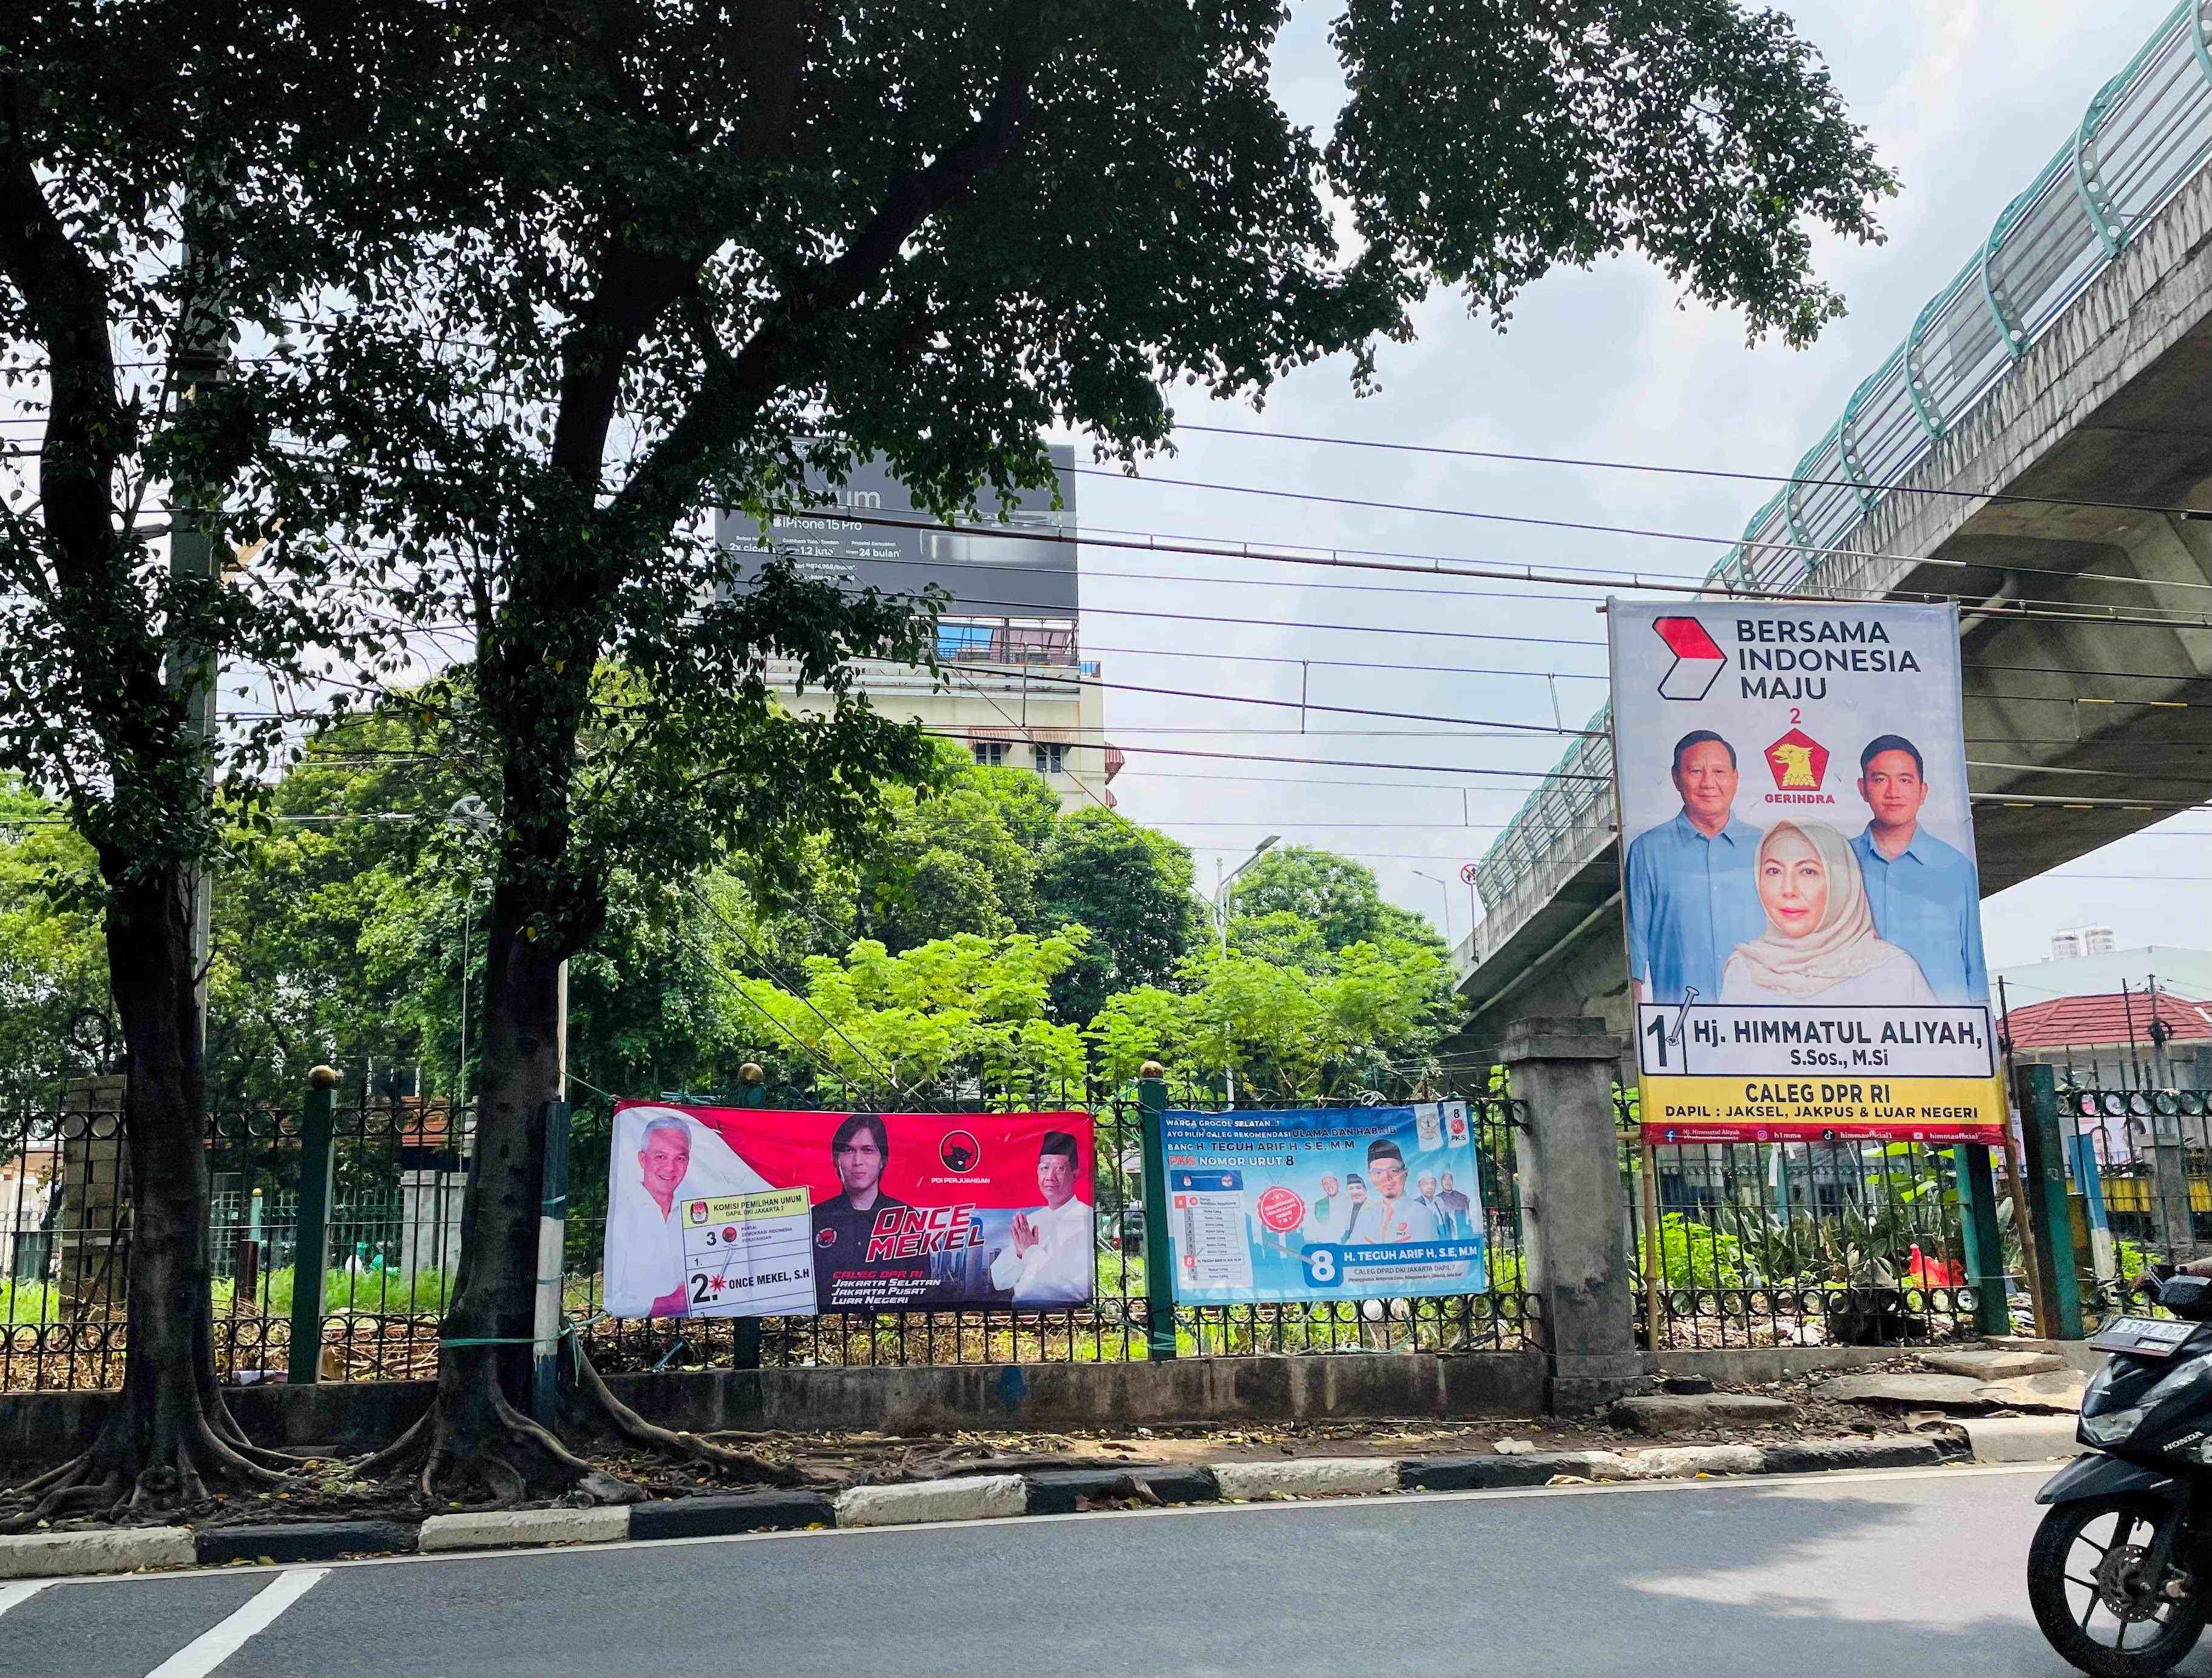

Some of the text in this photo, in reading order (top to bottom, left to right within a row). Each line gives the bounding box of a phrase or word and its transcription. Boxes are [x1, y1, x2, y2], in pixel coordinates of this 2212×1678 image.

[783, 516, 862, 530] iPhone 15 Pro
[859, 547, 871, 557] 24
[1737, 620, 1890, 643] BERSAMA
[1739, 648, 1921, 672] INDONESIA
[1741, 677, 1827, 700] MAJU
[1790, 708, 1801, 724] 2
[1764, 793, 1835, 804] GERINDRA
[1647, 1015, 1667, 1067] 1
[1694, 1020, 1982, 1049] Hj. HIMMATUL ALIYAH,
[1791, 1049, 1889, 1068] S.Sos., M.Si
[1745, 1083, 1890, 1103] CALEG DPR RI
[1453, 1109, 1459, 1118] 8
[1666, 1106, 1978, 1119] DAPIL : JAKSEL, JAKPUS & LUAR NEGERI
[1292, 1129, 1329, 1137] ULAMA
[1331, 1128, 1354, 1137] DAN
[1356, 1126, 1396, 1135] HABAIB
[1196, 1142, 1208, 1151] H.
[1211, 1142, 1253, 1151] TEGUH
[1257, 1142, 1285, 1151] ARIF
[1330, 1140, 1355, 1149] M.M
[1168, 1155, 1294, 1166] PKS NOMOR URUT 8
[741, 1199, 779, 1209] PEMILIHAN
[781, 1195, 802, 1204] UMUM
[871, 1203, 976, 1237] ONCE
[706, 1231, 717, 1246] 3
[865, 1225, 985, 1262] MEKEL
[694, 1257, 702, 1266] 1.
[1186, 1257, 1192, 1265] 8
[1344, 1246, 1477, 1262] H. TEGUH ARIF H, S.E, M.M
[1311, 1250, 1336, 1282] 8
[691, 1268, 810, 1304] 2. ONCE MEKEL, S.H
[831, 1278, 941, 1287] JAKARTA SELATAN
[831, 1296, 909, 1305] LUAR NEGERI
[2163, 1431, 2205, 1451] HONDA
